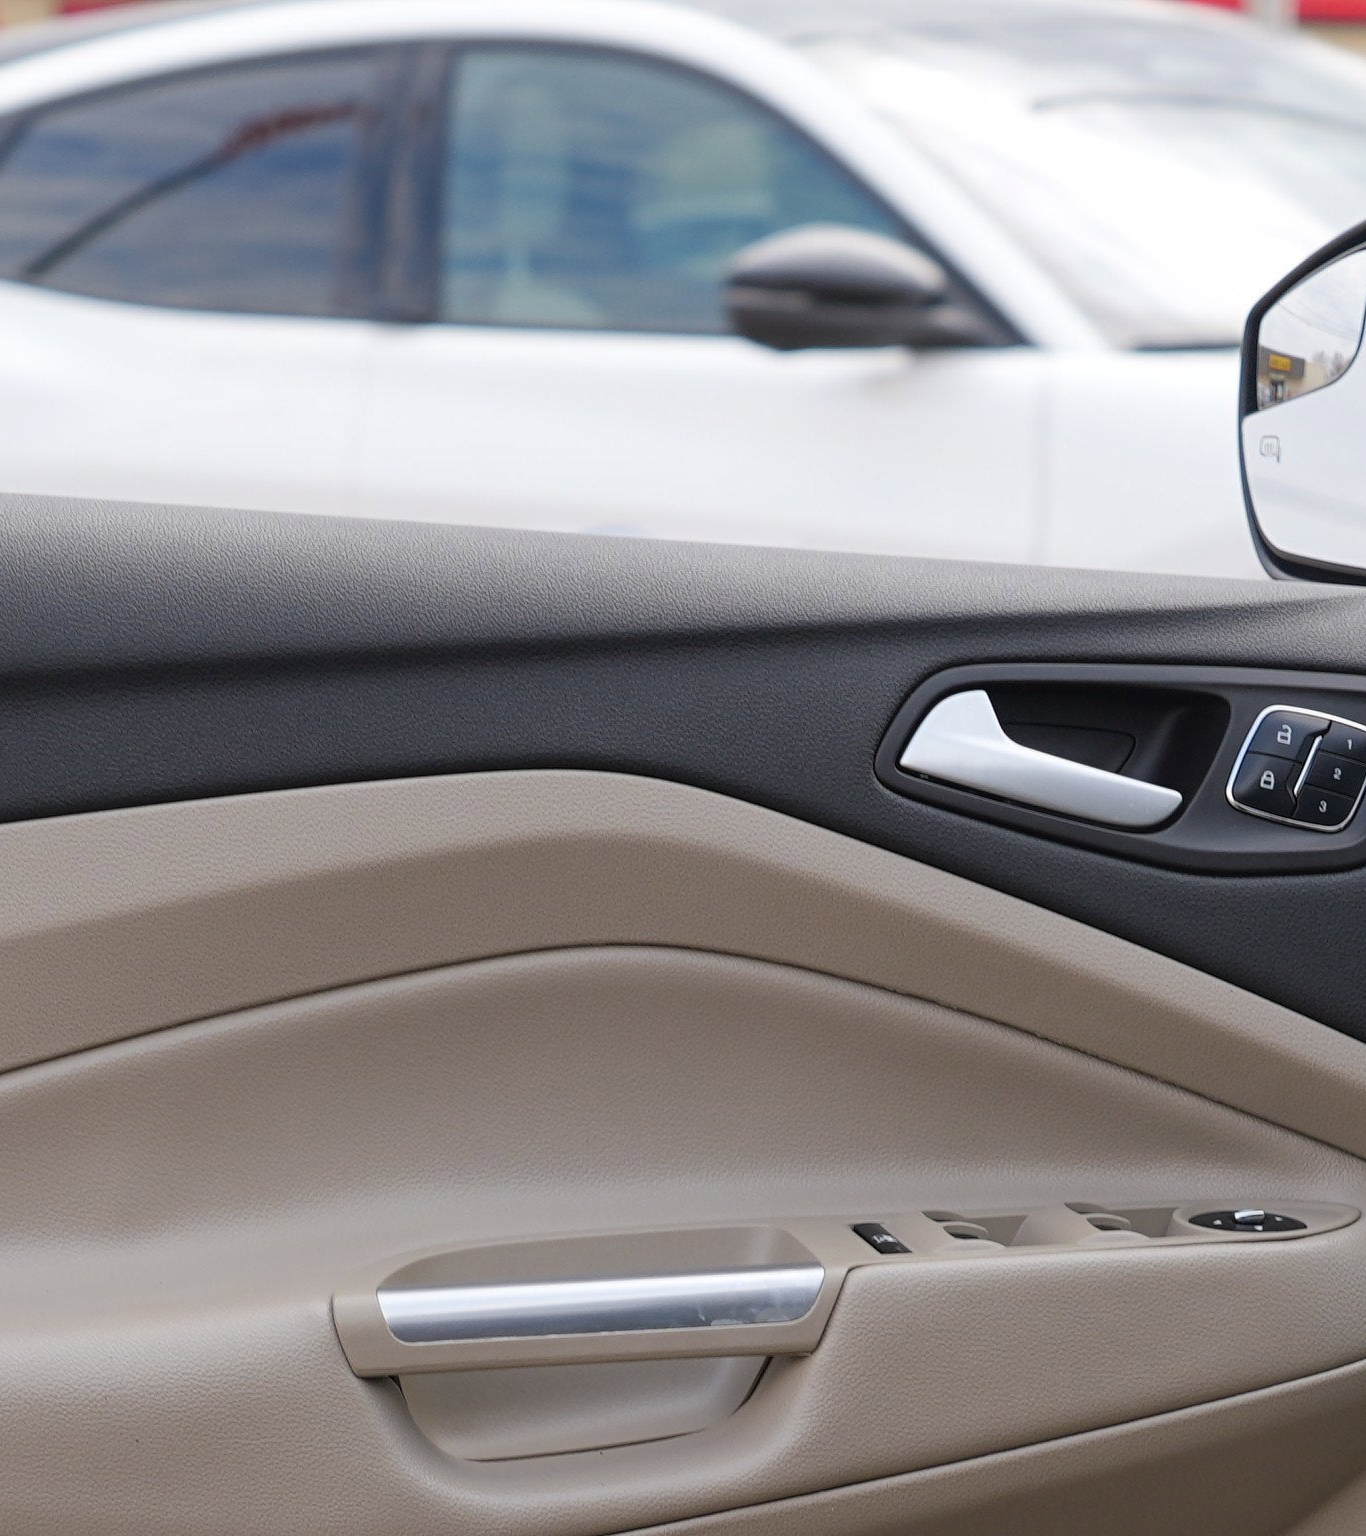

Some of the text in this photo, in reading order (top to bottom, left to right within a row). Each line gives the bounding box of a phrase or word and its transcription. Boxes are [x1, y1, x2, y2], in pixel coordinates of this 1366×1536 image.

[1346, 738, 1353, 751] 1
[1333, 767, 1342, 781] 2
[1318, 800, 1327, 813] 3
